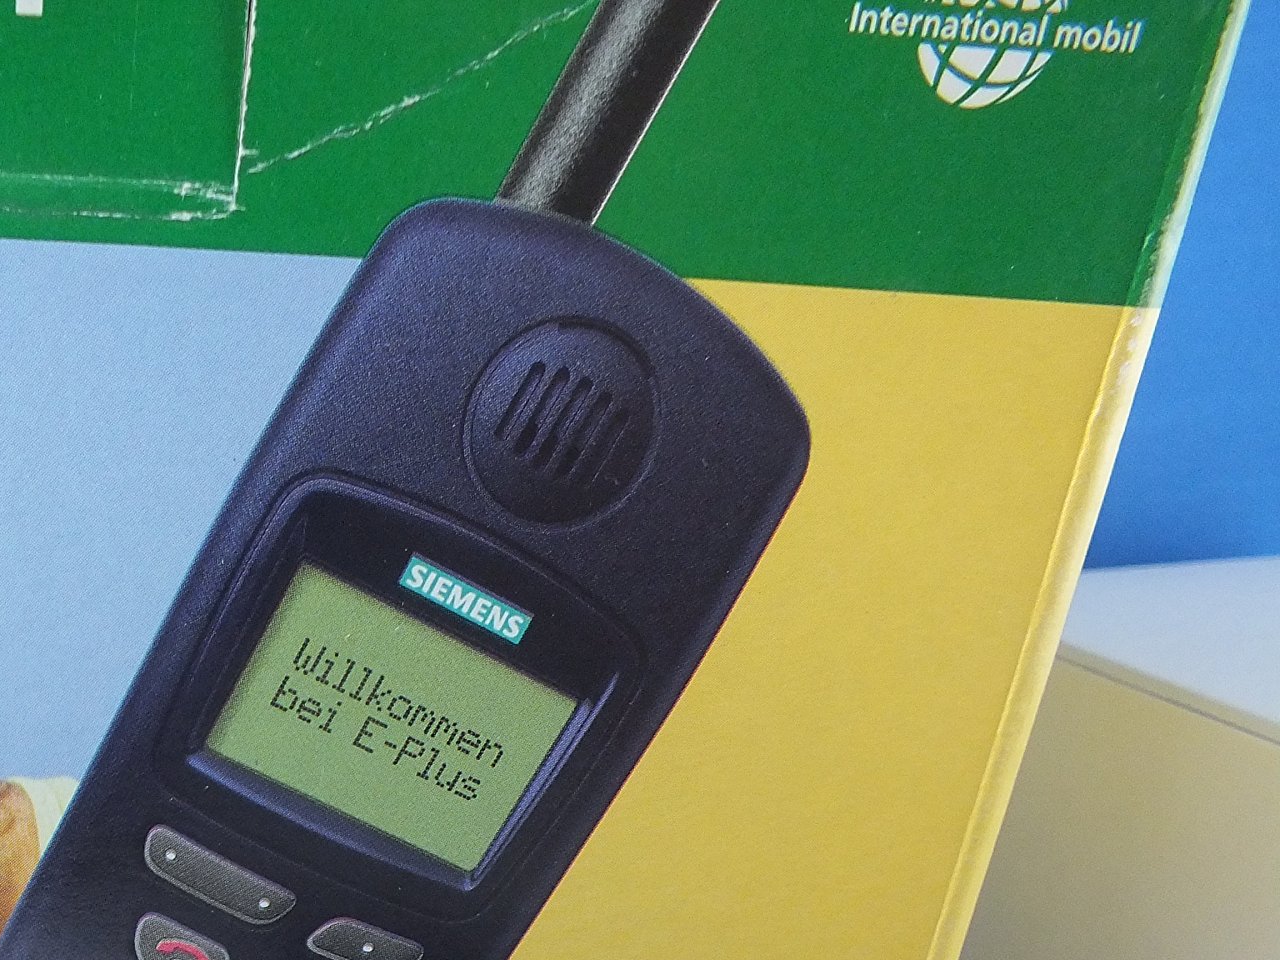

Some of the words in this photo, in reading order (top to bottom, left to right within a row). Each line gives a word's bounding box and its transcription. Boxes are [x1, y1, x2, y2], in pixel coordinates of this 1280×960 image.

[848, 1, 1051, 46] International
[1053, 19, 1142, 53] mobil
[405, 563, 526, 640] SIEMENS
[270, 675, 343, 734] bei
[353, 715, 482, 801] E-Plus
[292, 637, 504, 768] Willkommen
